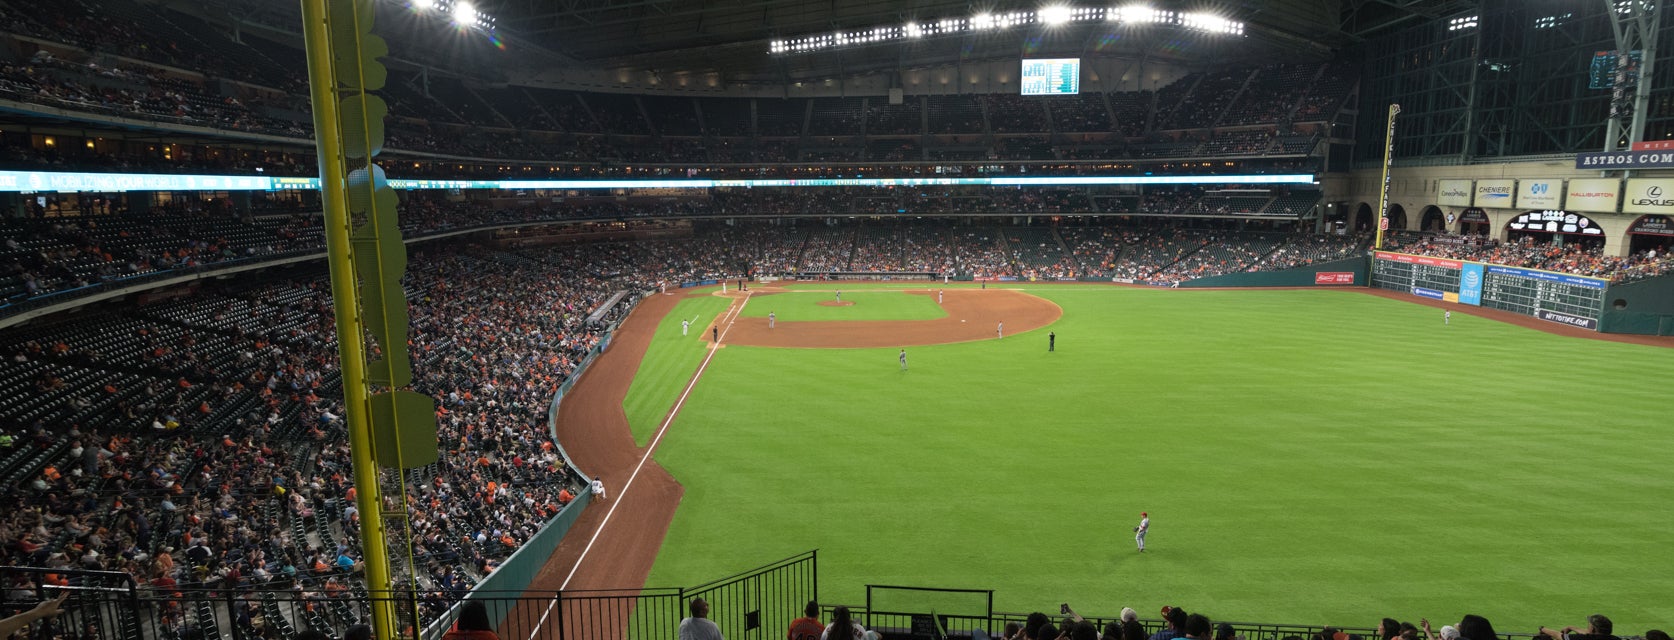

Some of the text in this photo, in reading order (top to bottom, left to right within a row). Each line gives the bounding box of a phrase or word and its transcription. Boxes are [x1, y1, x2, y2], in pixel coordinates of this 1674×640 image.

[1583, 155, 1633, 165] ASTROS
[50, 175, 115, 188] MOBILIZING
[115, 176, 144, 188] YOUR
[145, 177, 178, 188] WORLD
[1478, 186, 1512, 194] CHENIERE
[1631, 199, 1674, 207] LEXUS
[1461, 288, 1479, 298] AT&T
[1545, 312, 1589, 328] NITTOTIRE.COM
